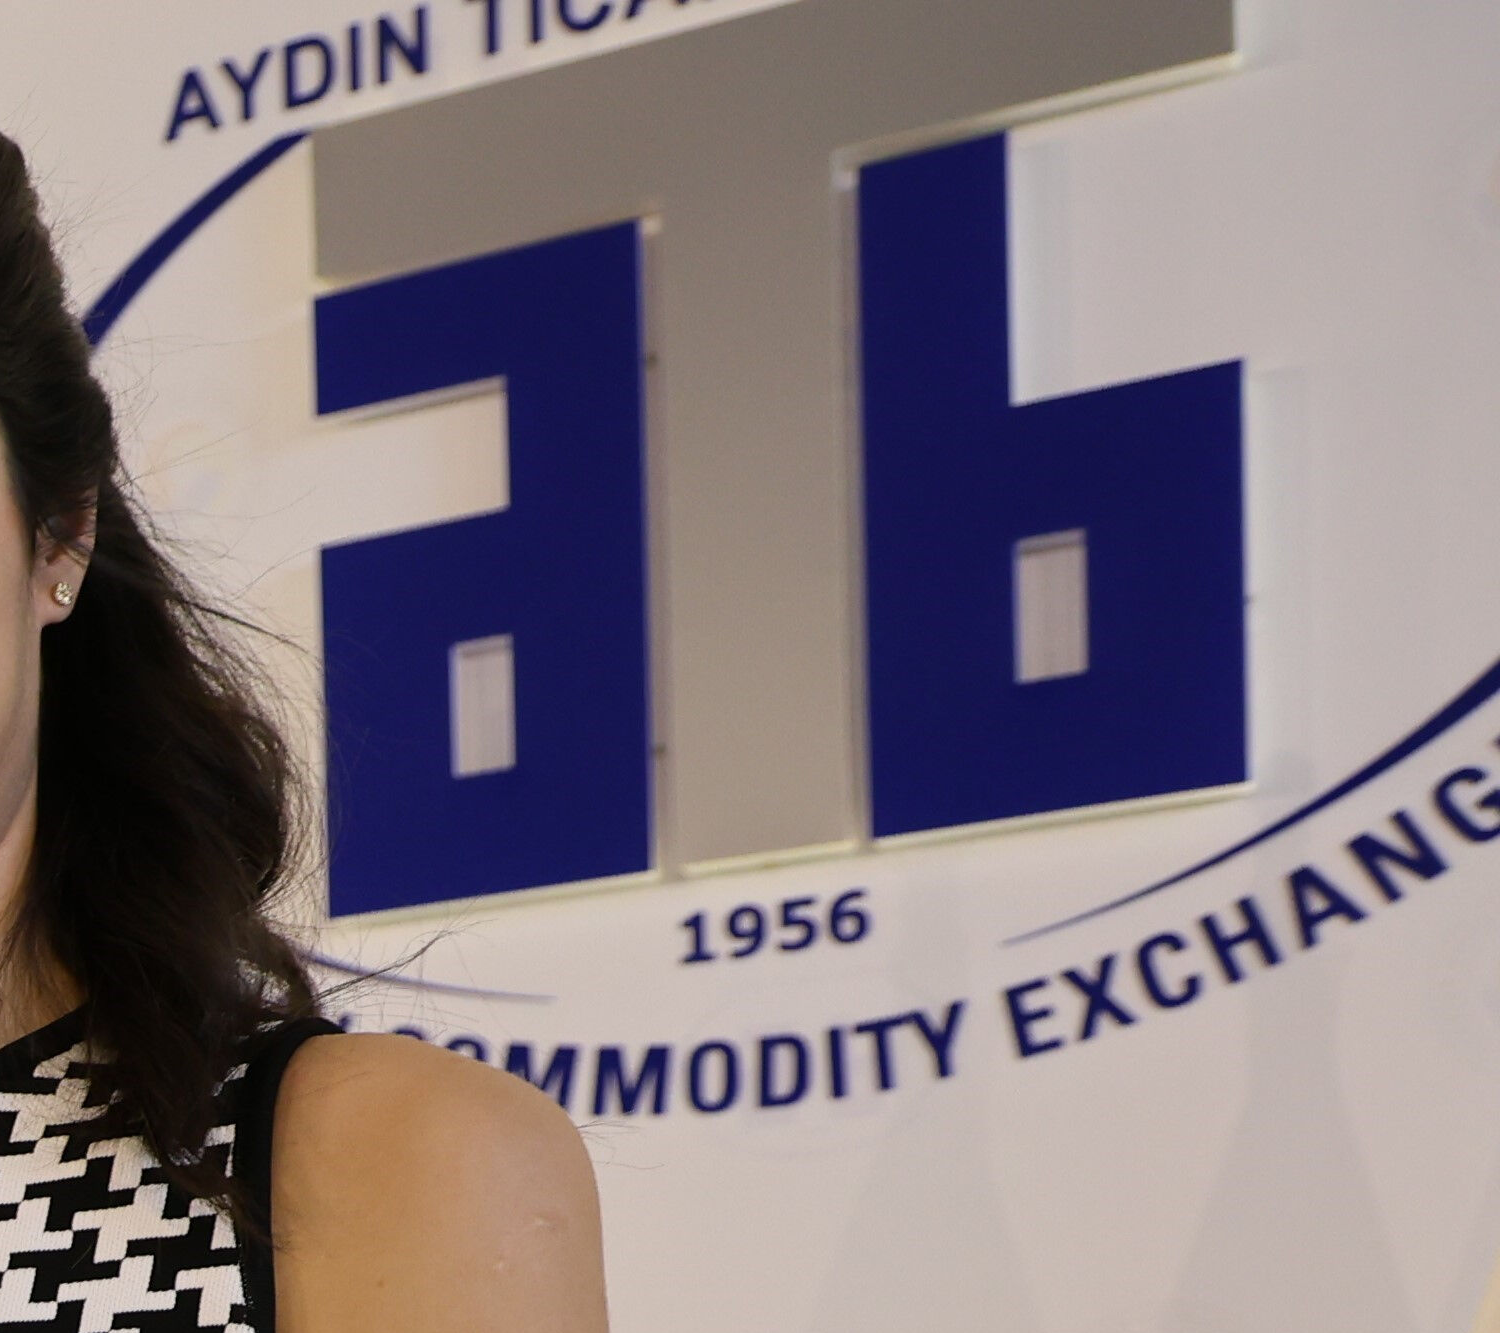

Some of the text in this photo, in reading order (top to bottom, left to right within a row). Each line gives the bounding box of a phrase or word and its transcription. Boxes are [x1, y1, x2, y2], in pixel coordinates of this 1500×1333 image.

[163, 5, 429, 142] AYDIN
[392, 730, 1500, 1118] MMODITY EXCHANG
[678, 888, 873, 965] 1956
